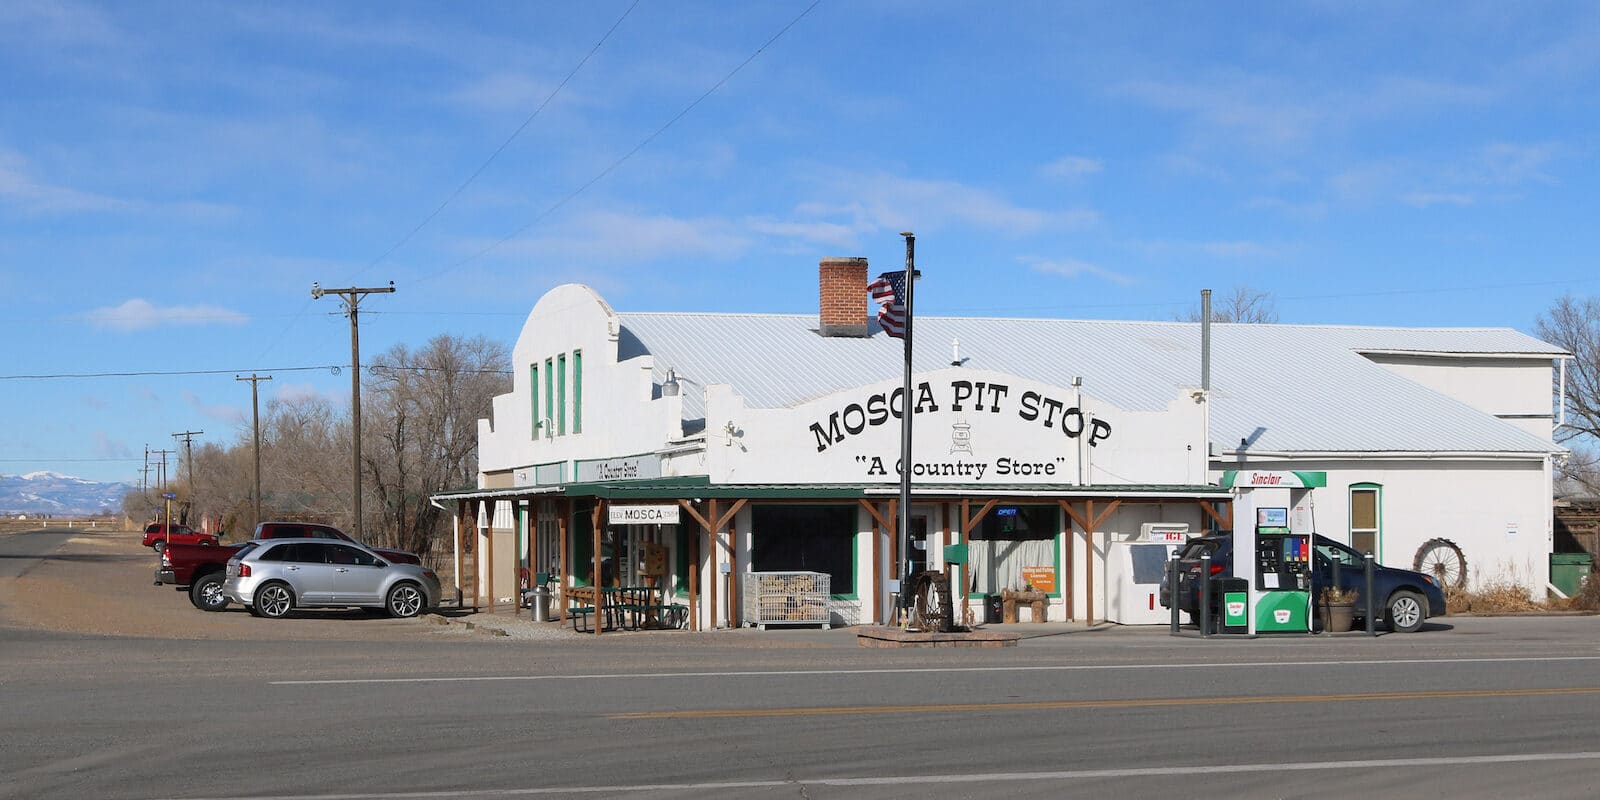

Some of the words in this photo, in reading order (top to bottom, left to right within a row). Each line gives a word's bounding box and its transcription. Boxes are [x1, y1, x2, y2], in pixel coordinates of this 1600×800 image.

[810, 381, 938, 453] MOSCA
[951, 380, 1008, 413] PIT
[1018, 391, 1112, 448] STOP
[1251, 472, 1282, 485] Sinclair
[625, 509, 662, 520] MOSCA
